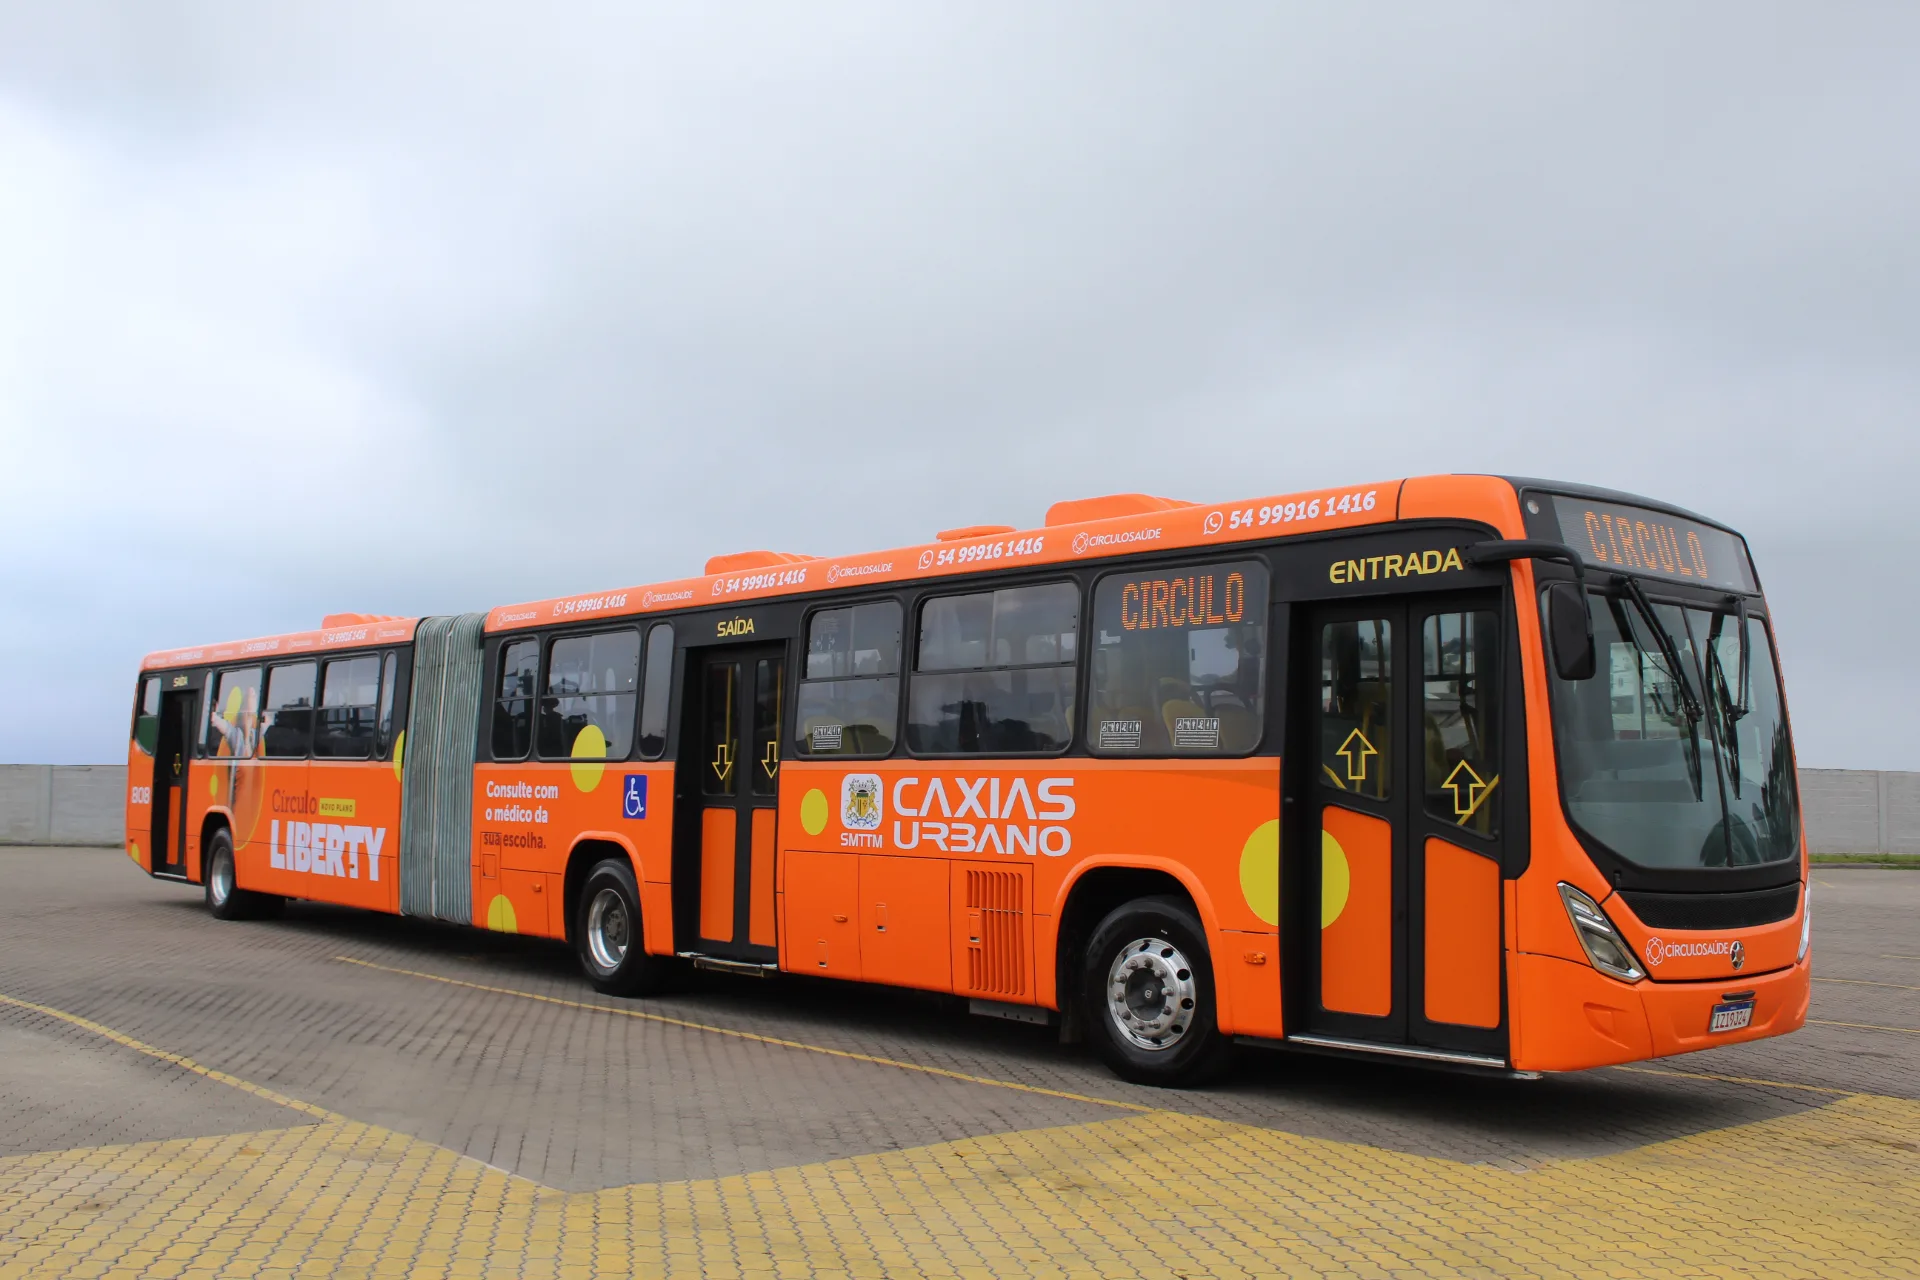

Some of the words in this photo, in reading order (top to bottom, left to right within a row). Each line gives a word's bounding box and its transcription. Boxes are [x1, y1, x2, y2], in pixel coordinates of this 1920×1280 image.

[1229, 509, 1253, 529] 54
[1259, 499, 1320, 526] 99916
[1324, 490, 1376, 516] 1416
[1089, 527, 1162, 547] CÍRCULOSAÚDE
[1584, 511, 1708, 579] CIRCULO
[936, 548, 956, 566] 54
[958, 541, 1003, 564] 99916
[1005, 536, 1044, 558] 1416
[1329, 547, 1463, 584] ENTRADA
[725, 579, 741, 593] 54
[741, 573, 777, 591] 99916
[777, 568, 807, 586] 1416
[564, 601, 576, 613] 54
[576, 597, 603, 612] 99916
[603, 593, 628, 608] 1416
[1121, 571, 1244, 630] CIRCULO
[717, 616, 755, 637] SAÍDA
[131, 786, 150, 804] 808
[486, 780, 532, 799] Consulte
[534, 784, 559, 799] com
[893, 777, 1076, 821] CAXIAS
[485, 809, 492, 821] o
[494, 805, 533, 823] médico
[534, 807, 549, 824] da
[270, 819, 387, 882] LIBERTY
[483, 833, 501, 846] sua
[502, 831, 547, 850] escolha.
[840, 832, 883, 849] SMTTM
[893, 820, 1072, 857] URBANO
